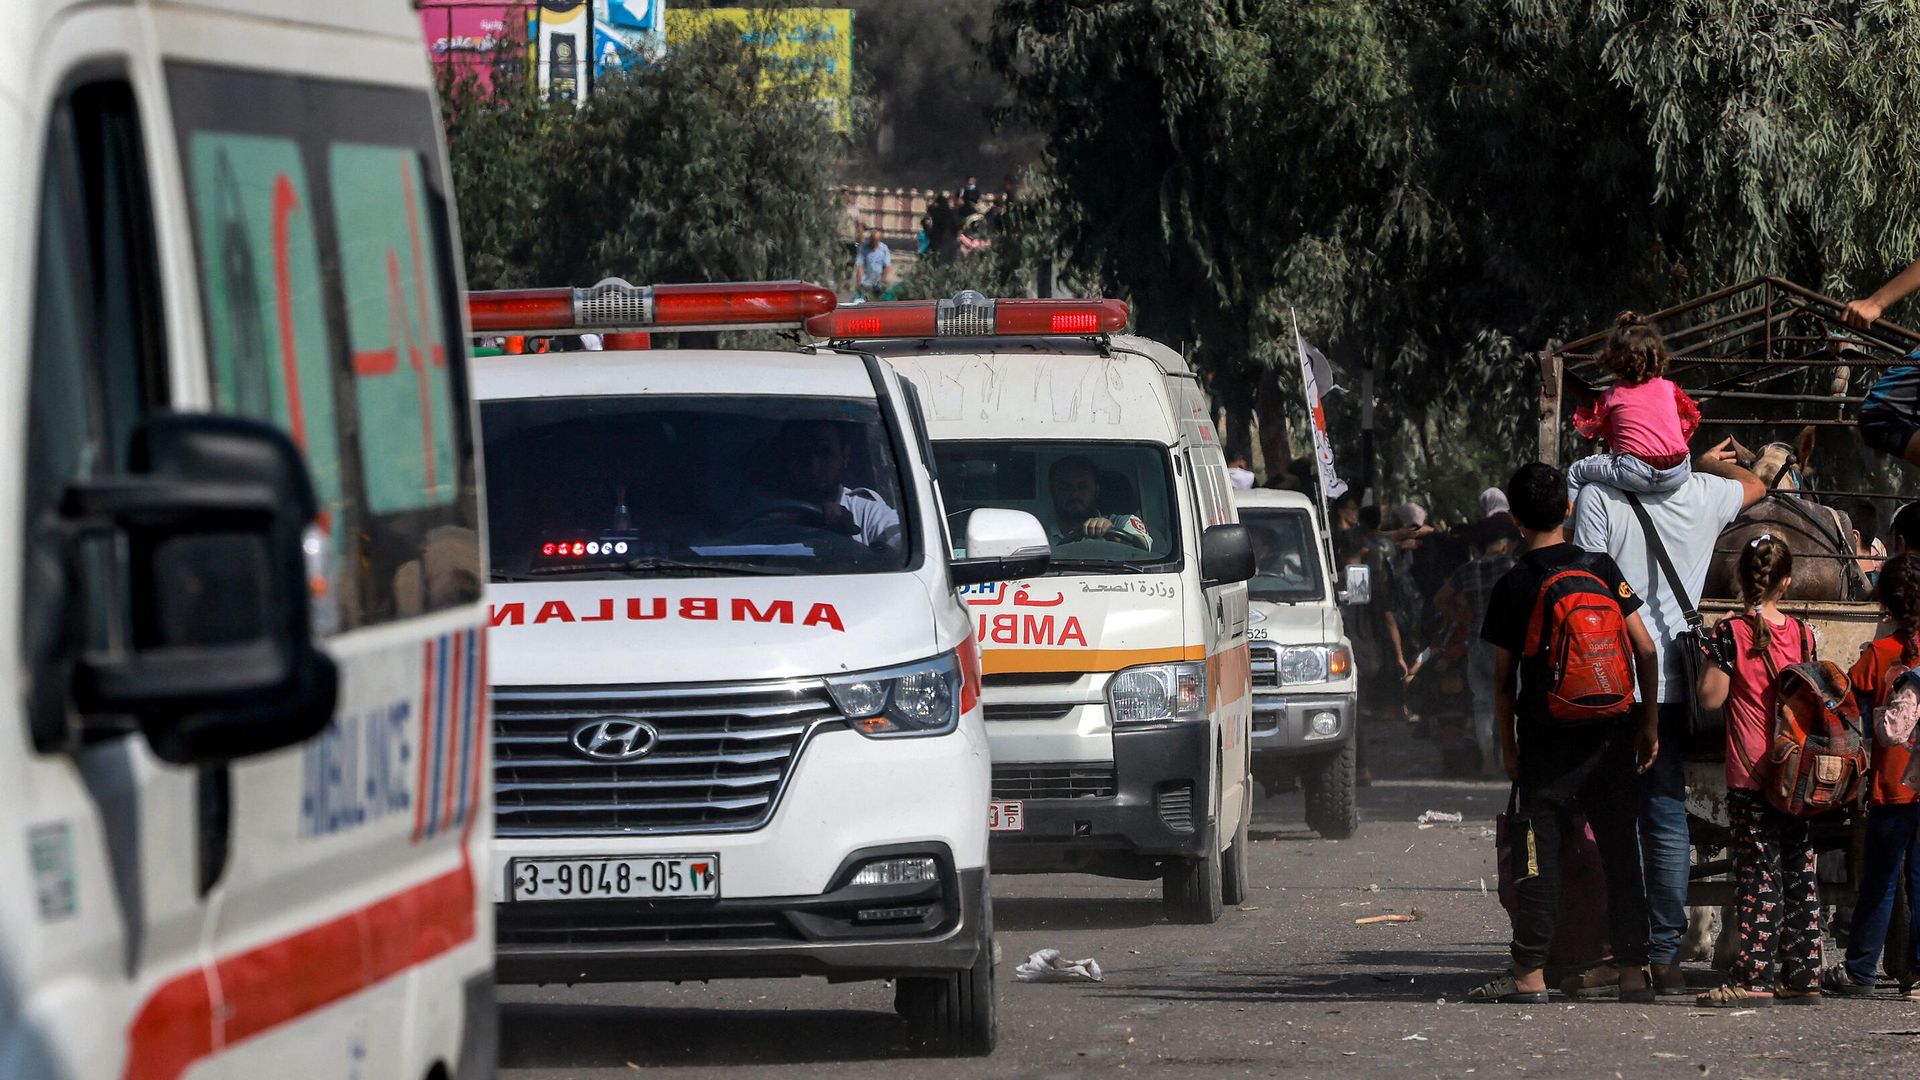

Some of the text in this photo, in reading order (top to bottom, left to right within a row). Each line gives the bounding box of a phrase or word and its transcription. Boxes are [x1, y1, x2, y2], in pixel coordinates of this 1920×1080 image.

[1079, 580, 1175, 598] وزارة الصحة
[523, 861, 682, 895] 3-9048-05
